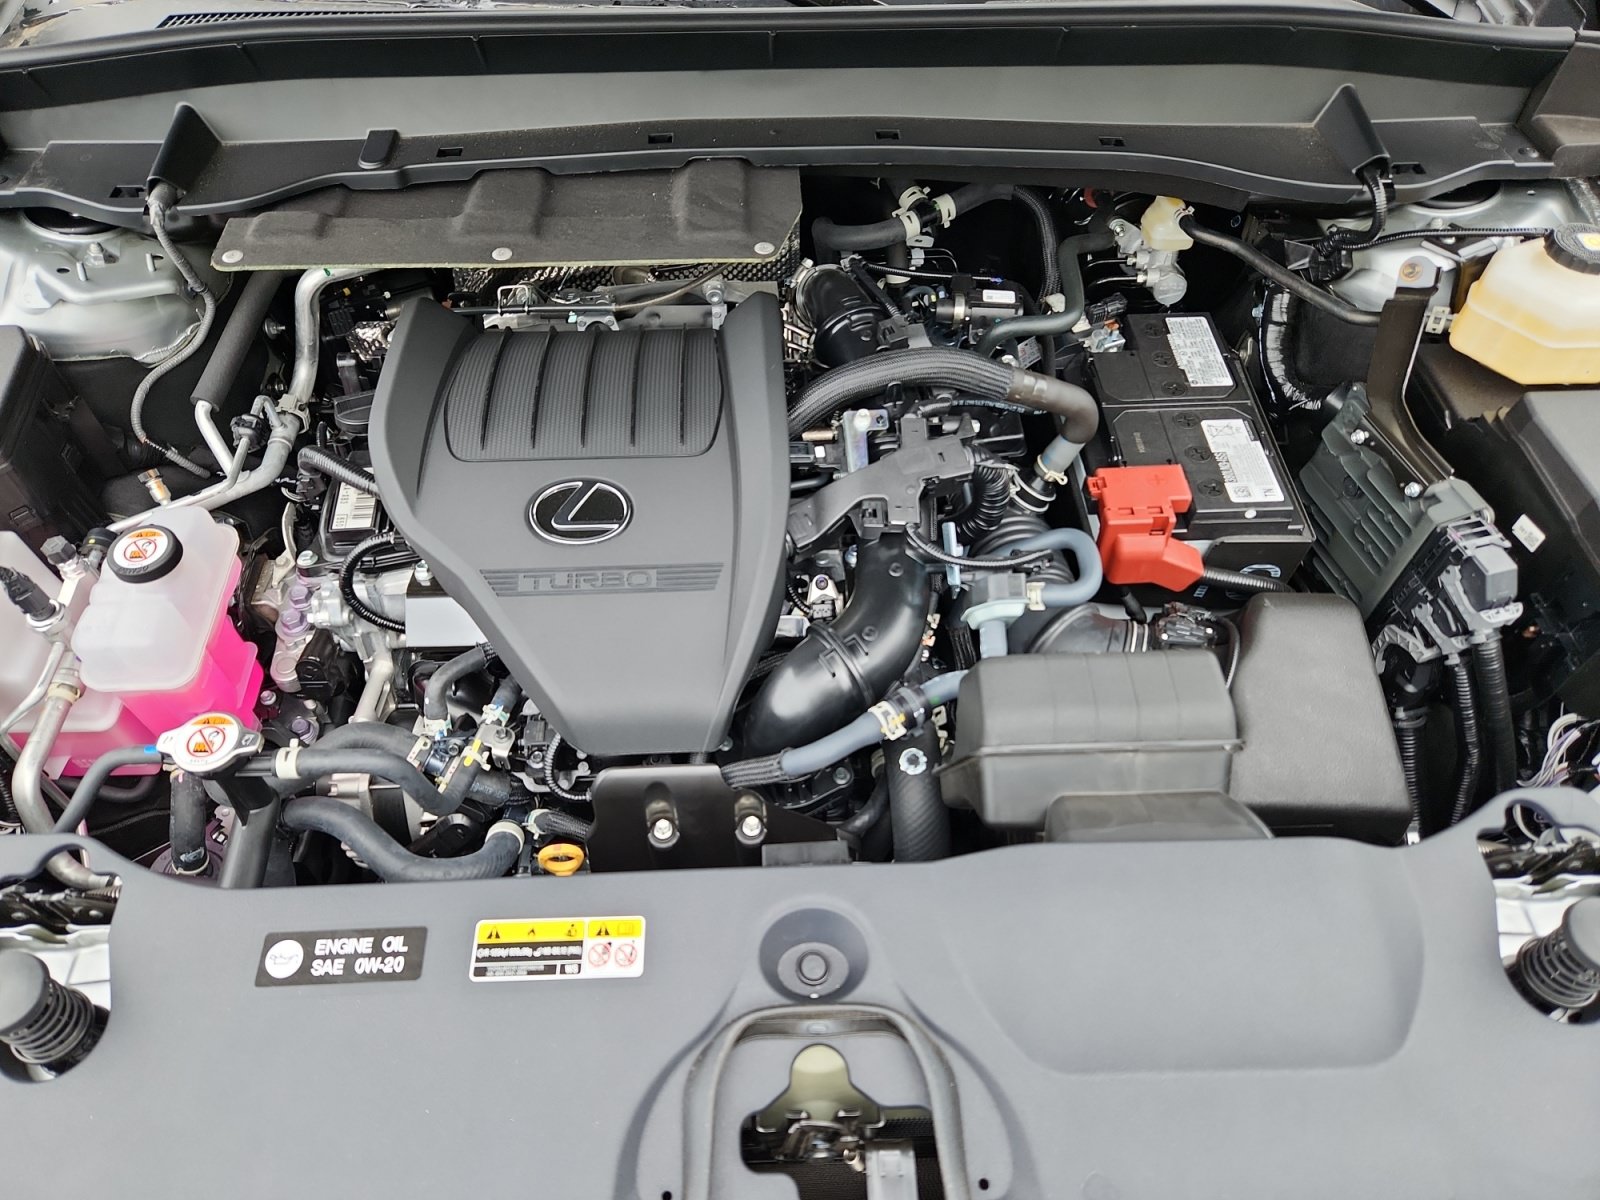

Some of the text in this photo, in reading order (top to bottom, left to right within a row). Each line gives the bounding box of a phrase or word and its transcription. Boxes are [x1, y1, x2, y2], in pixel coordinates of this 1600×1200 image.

[523, 571, 652, 590] TURBO
[314, 936, 408, 955] ENGINE OIL
[311, 956, 405, 976] SAE 0W-20
